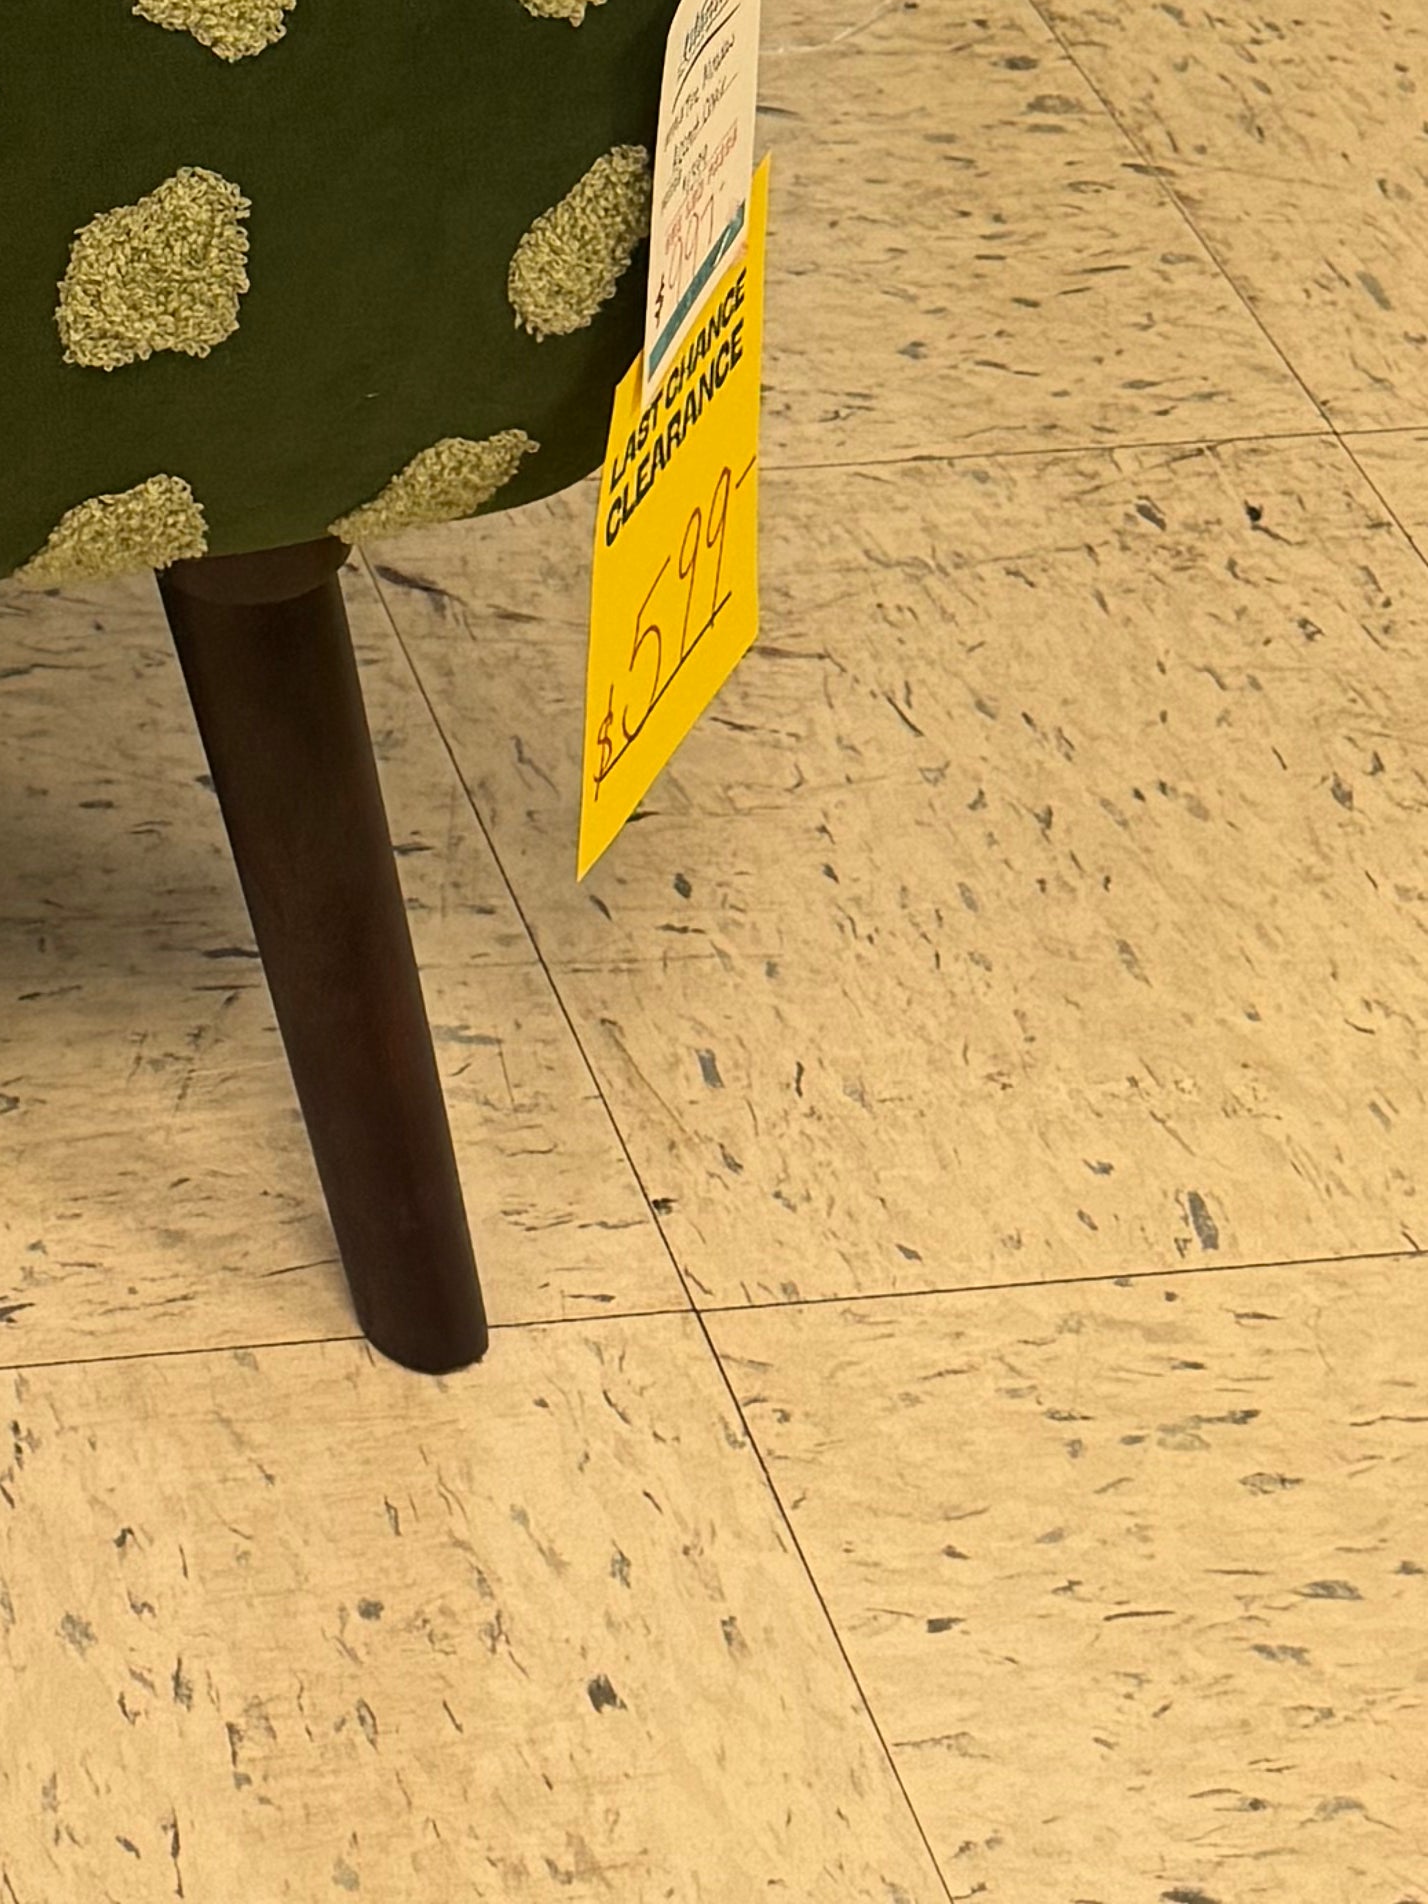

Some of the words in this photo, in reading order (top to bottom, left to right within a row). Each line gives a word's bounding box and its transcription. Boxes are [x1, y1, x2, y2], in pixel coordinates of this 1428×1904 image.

[606, 317, 745, 547] CLEARANCE
[610, 389, 663, 493] LAST
[665, 266, 746, 410] CHANCE
